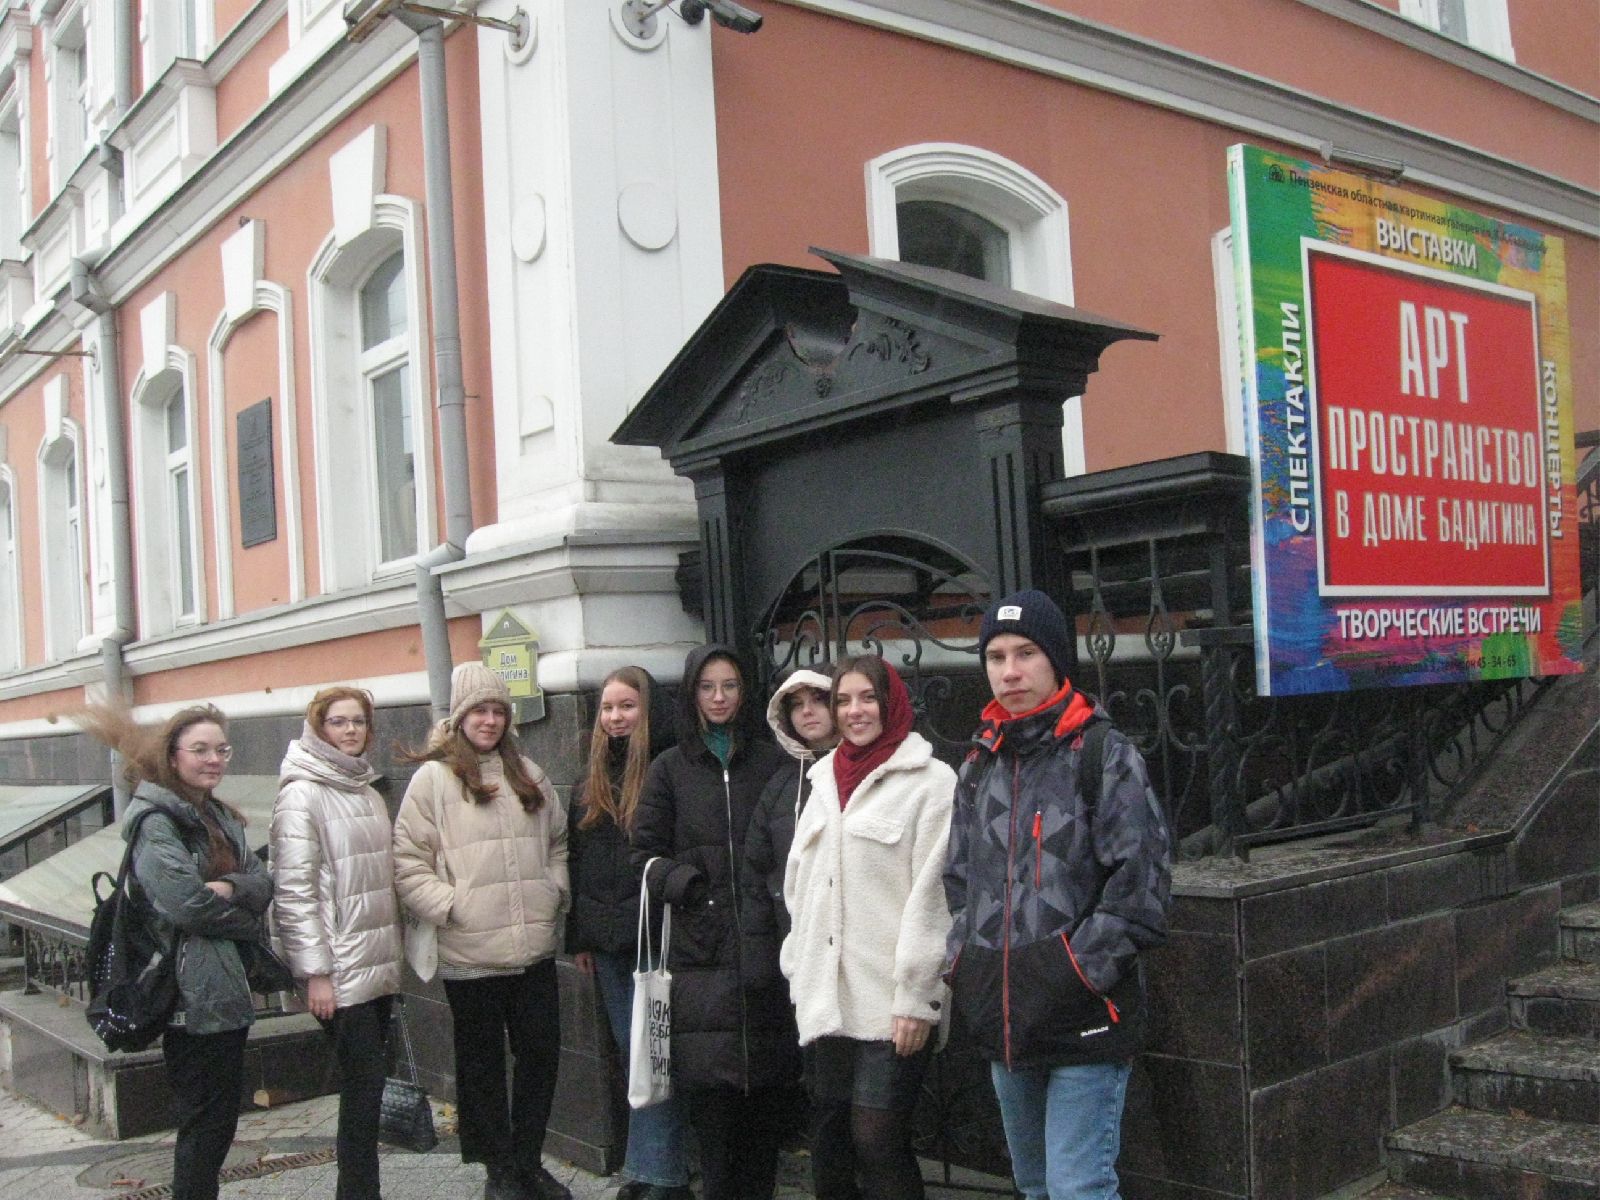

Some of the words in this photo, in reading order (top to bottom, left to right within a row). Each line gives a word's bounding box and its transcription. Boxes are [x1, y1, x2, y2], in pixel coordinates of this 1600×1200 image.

[1288, 169, 1349, 200] Пензенская
[1350, 189, 1398, 214] областная
[1399, 202, 1446, 226] картинная
[1376, 216, 1478, 270] ВЫСТАВКИ
[1400, 300, 1469, 404] АРТ
[1280, 302, 1310, 533] СПЕКТАКЛИ
[1328, 405, 1537, 488] ПРОСТРАНСТВО
[1543, 360, 1564, 538] КОНЦЕРТЫ
[1336, 489, 1350, 538] В
[1363, 491, 1427, 547] ДОМЕ
[1438, 497, 1537, 551] БАДИГИНА
[1337, 607, 1465, 639] ТВОРЧЕСКИЕ
[1468, 607, 1541, 635] ВСТРЕЧИ
[500, 652, 516, 667] Дом
